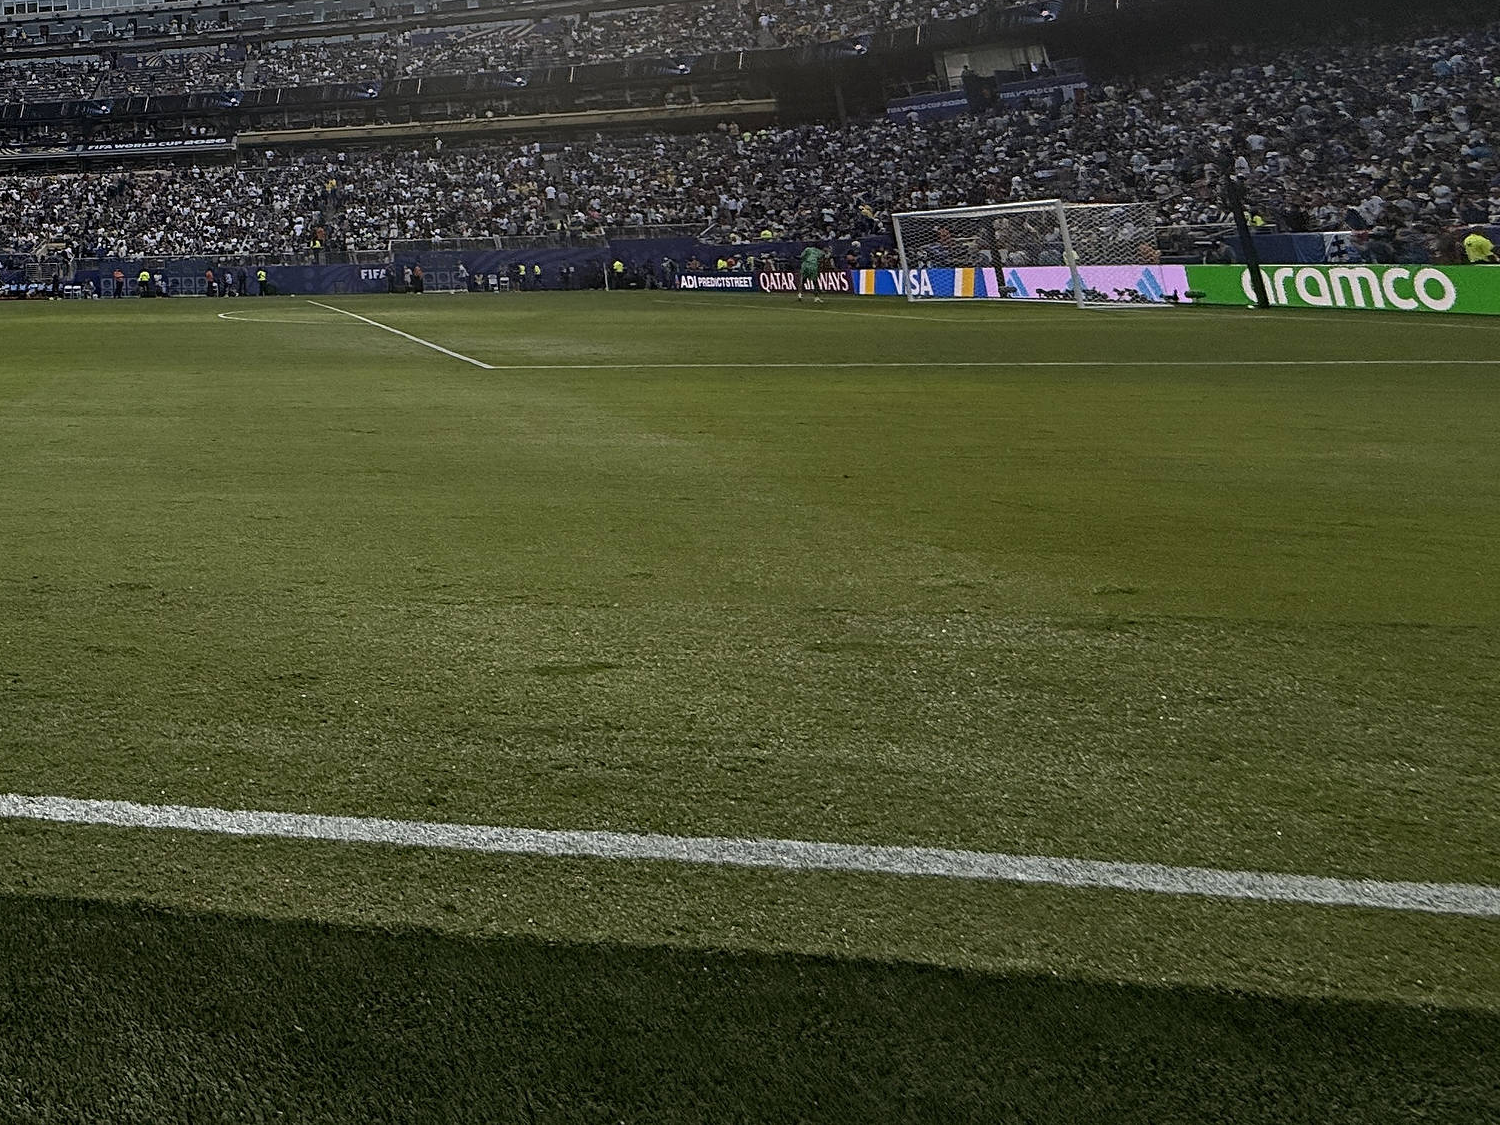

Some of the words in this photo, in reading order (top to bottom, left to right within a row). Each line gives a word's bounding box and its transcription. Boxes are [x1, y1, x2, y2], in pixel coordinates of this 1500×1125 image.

[361, 269, 386, 279] FIFA
[680, 275, 697, 288] ADI
[697, 276, 752, 287] PREDICTSTREET
[760, 272, 797, 292] QATAR
[887, 269, 934, 295] VSA
[1241, 267, 1456, 311] aramco
